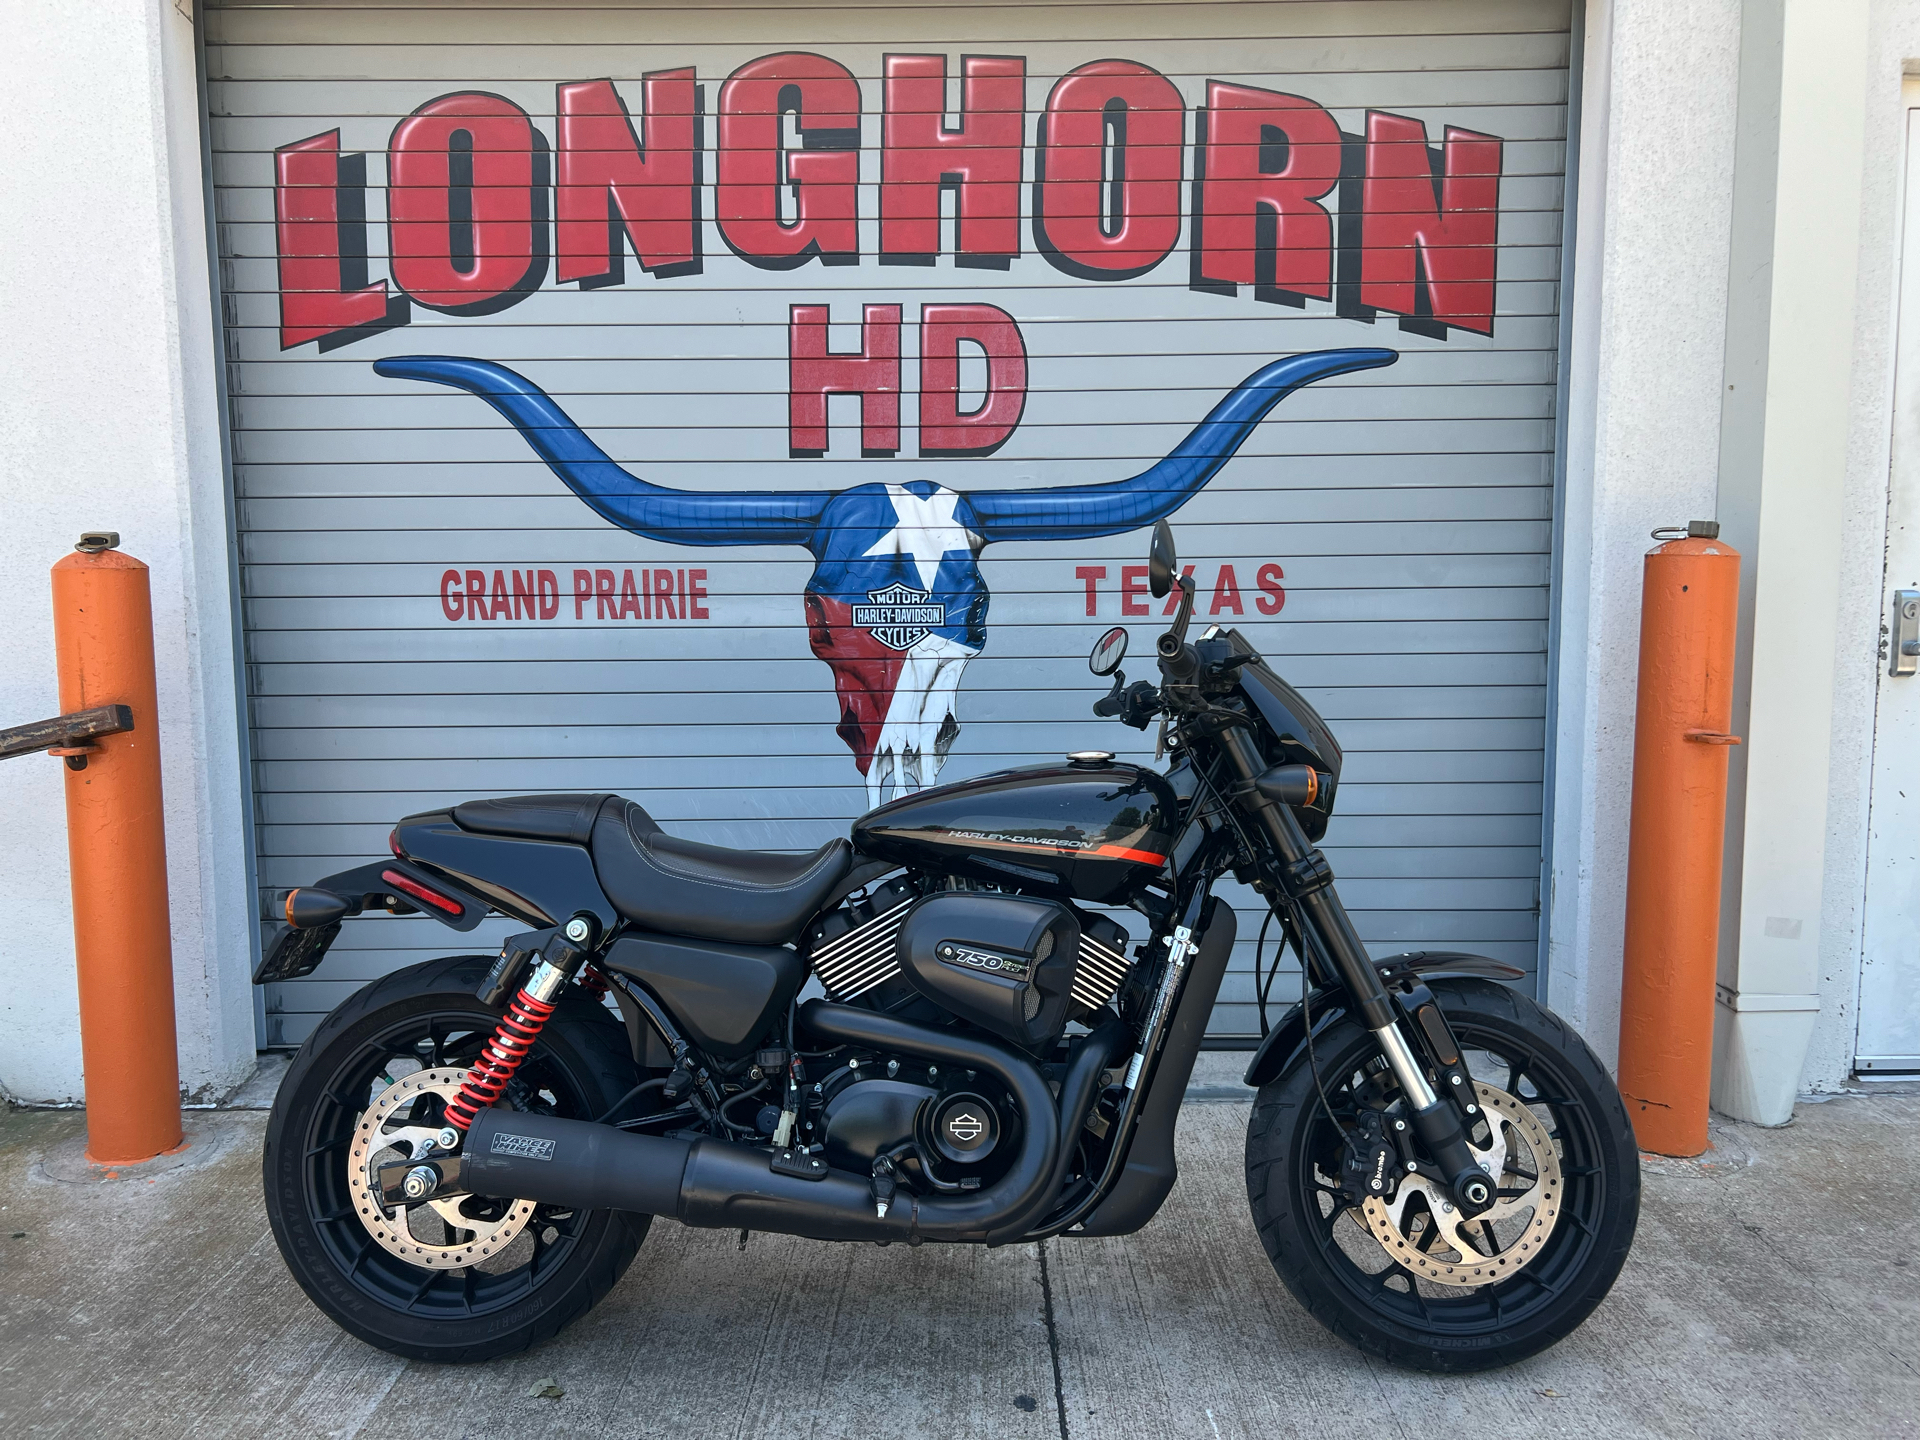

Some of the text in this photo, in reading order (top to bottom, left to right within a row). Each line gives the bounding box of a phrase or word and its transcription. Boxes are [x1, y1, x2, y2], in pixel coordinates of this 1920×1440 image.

[274, 50, 1504, 354] LONGHORN
[788, 302, 1029, 459] HD
[440, 568, 710, 621] GRAND PRAIRIE
[876, 587, 921, 604] MOTOR
[857, 607, 940, 623] HARLEY-DAVIDSON
[877, 627, 922, 647] CYCLES
[948, 830, 1094, 849] HARLEY-DAVIDSON
[956, 948, 1004, 970] 750
[1374, 1151, 1386, 1179] brembo
[282, 1147, 365, 1313] HARLEY-DAVIDSON
[1417, 1334, 1491, 1348] MICHELIN
